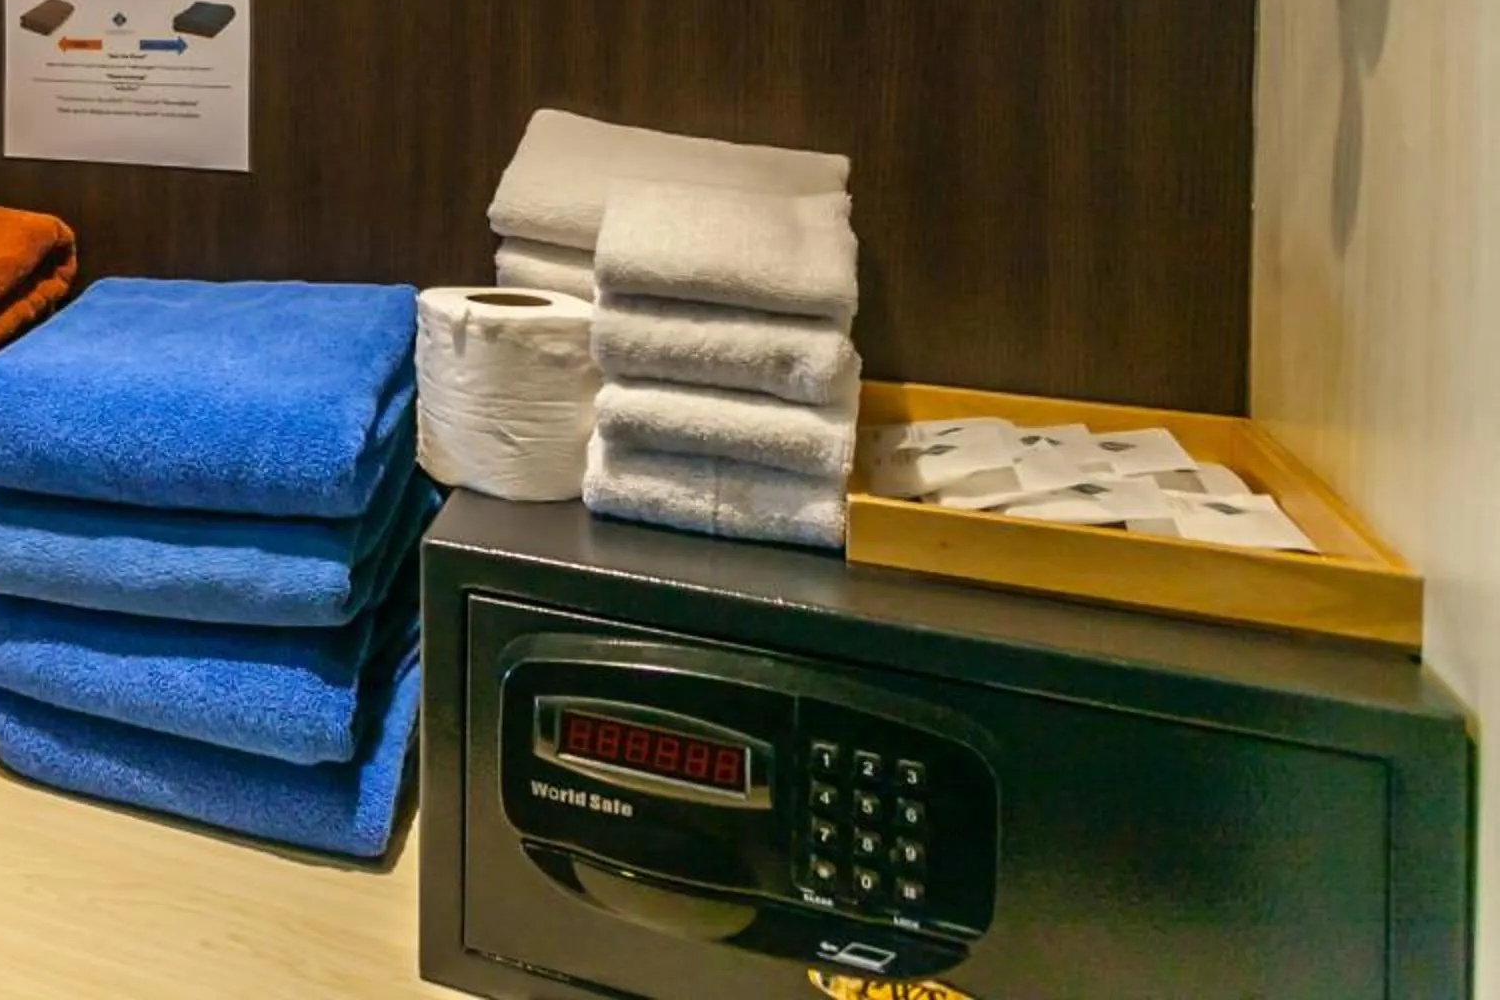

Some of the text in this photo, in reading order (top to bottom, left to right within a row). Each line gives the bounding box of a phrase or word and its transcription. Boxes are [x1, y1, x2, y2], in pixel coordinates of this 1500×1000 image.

[822, 752, 918, 785] 1 2 3
[531, 780, 587, 808] World
[819, 791, 918, 823] 4 5 6
[820, 827, 917, 862] 7 8 9
[861, 874, 873, 890] 0
